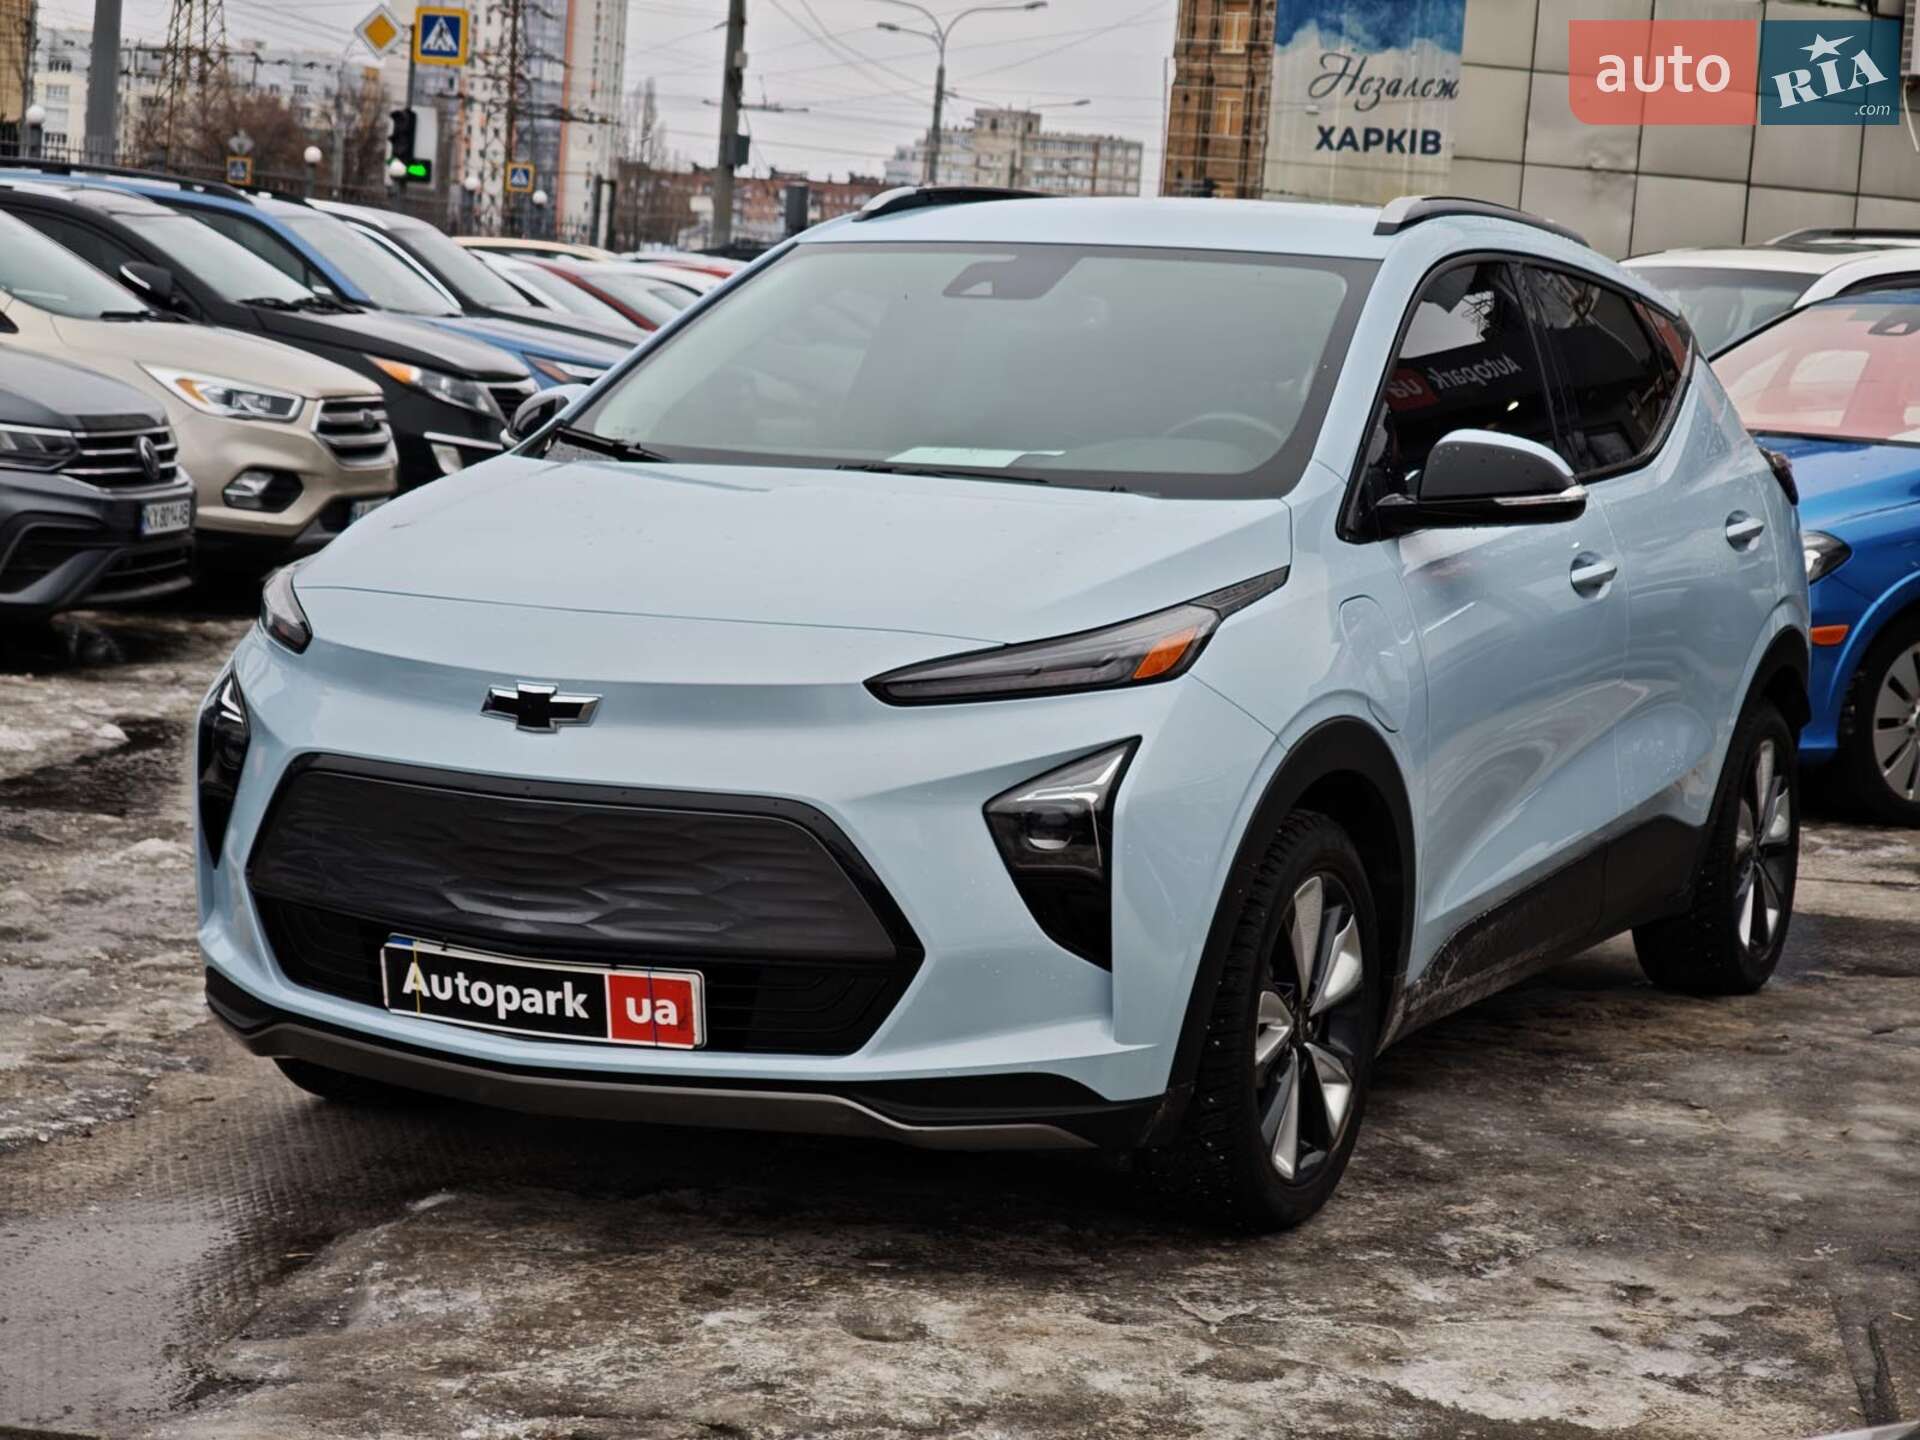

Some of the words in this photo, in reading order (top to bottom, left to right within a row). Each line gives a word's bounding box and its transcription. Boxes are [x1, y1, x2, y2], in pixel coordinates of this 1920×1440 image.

[1315, 125, 1442, 155] ХАРКІВ
[402, 962, 590, 1019] Autopark
[625, 995, 679, 1026] ua
